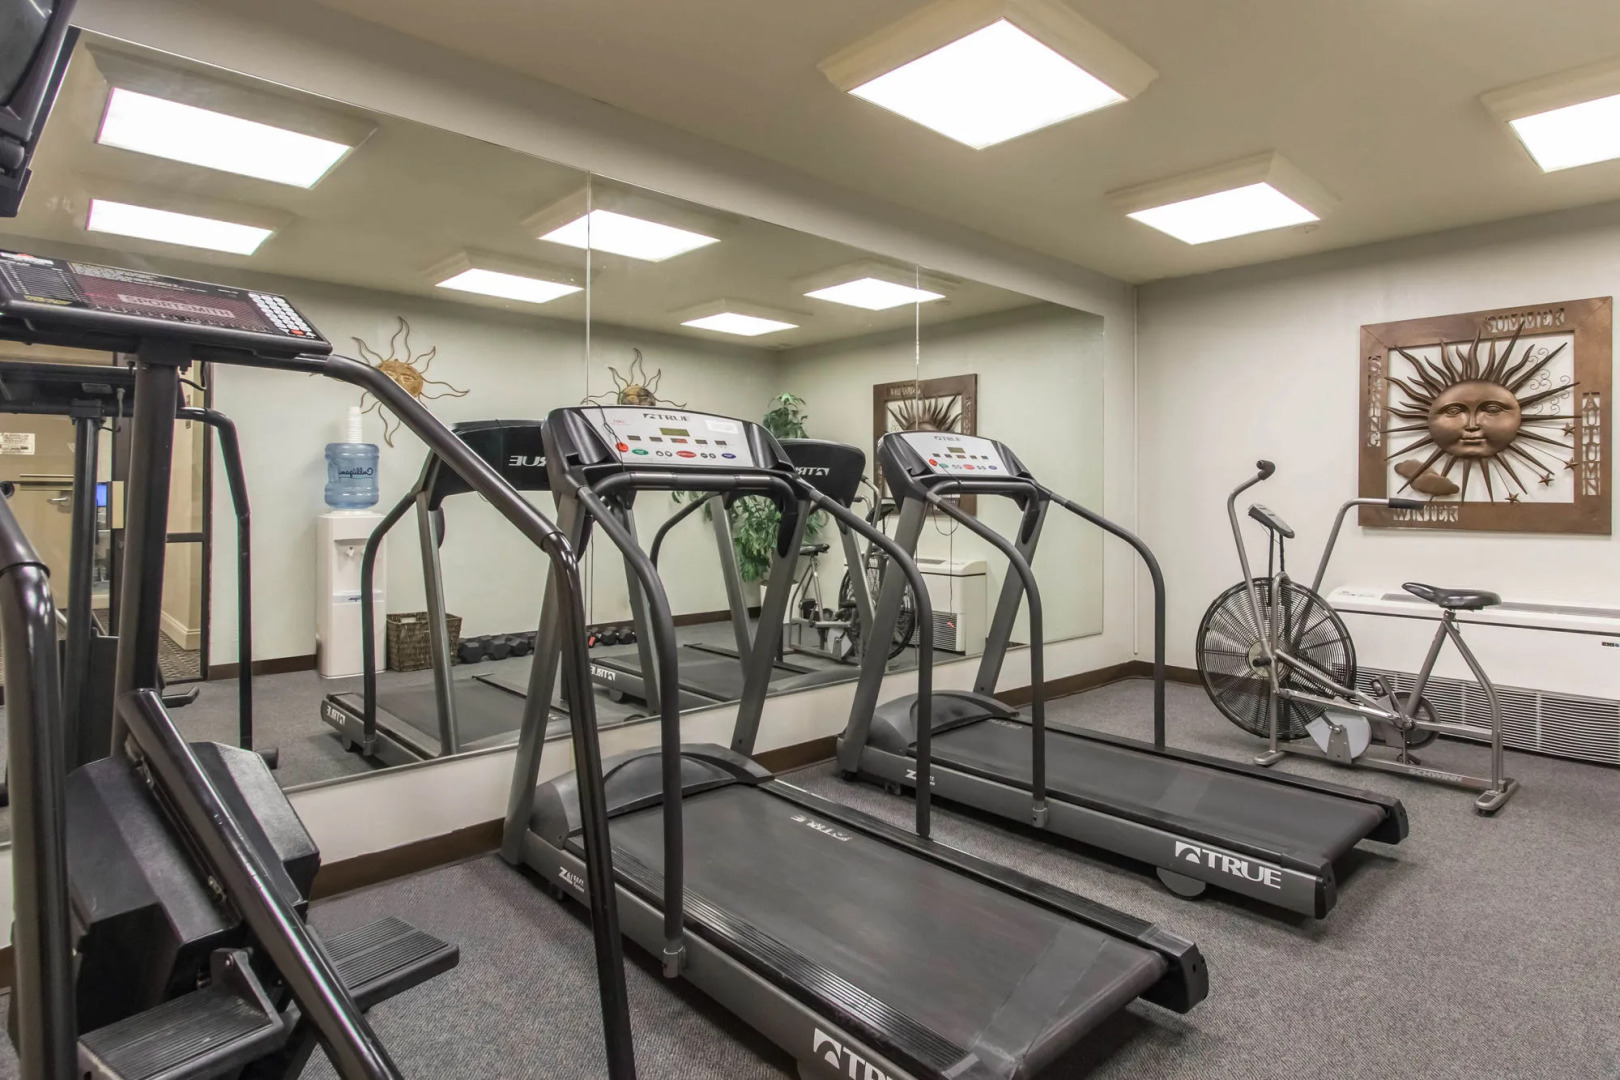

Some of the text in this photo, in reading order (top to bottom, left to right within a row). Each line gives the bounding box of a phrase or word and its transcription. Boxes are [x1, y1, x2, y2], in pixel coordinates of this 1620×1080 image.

[1485, 308, 1565, 333] SUMMER
[1368, 356, 1381, 447] SPRING
[1582, 392, 1600, 495] AUTUMN
[1393, 505, 1459, 522] WINTER
[1409, 768, 1462, 782] SCHWINN
[1202, 848, 1282, 889] TRUE
